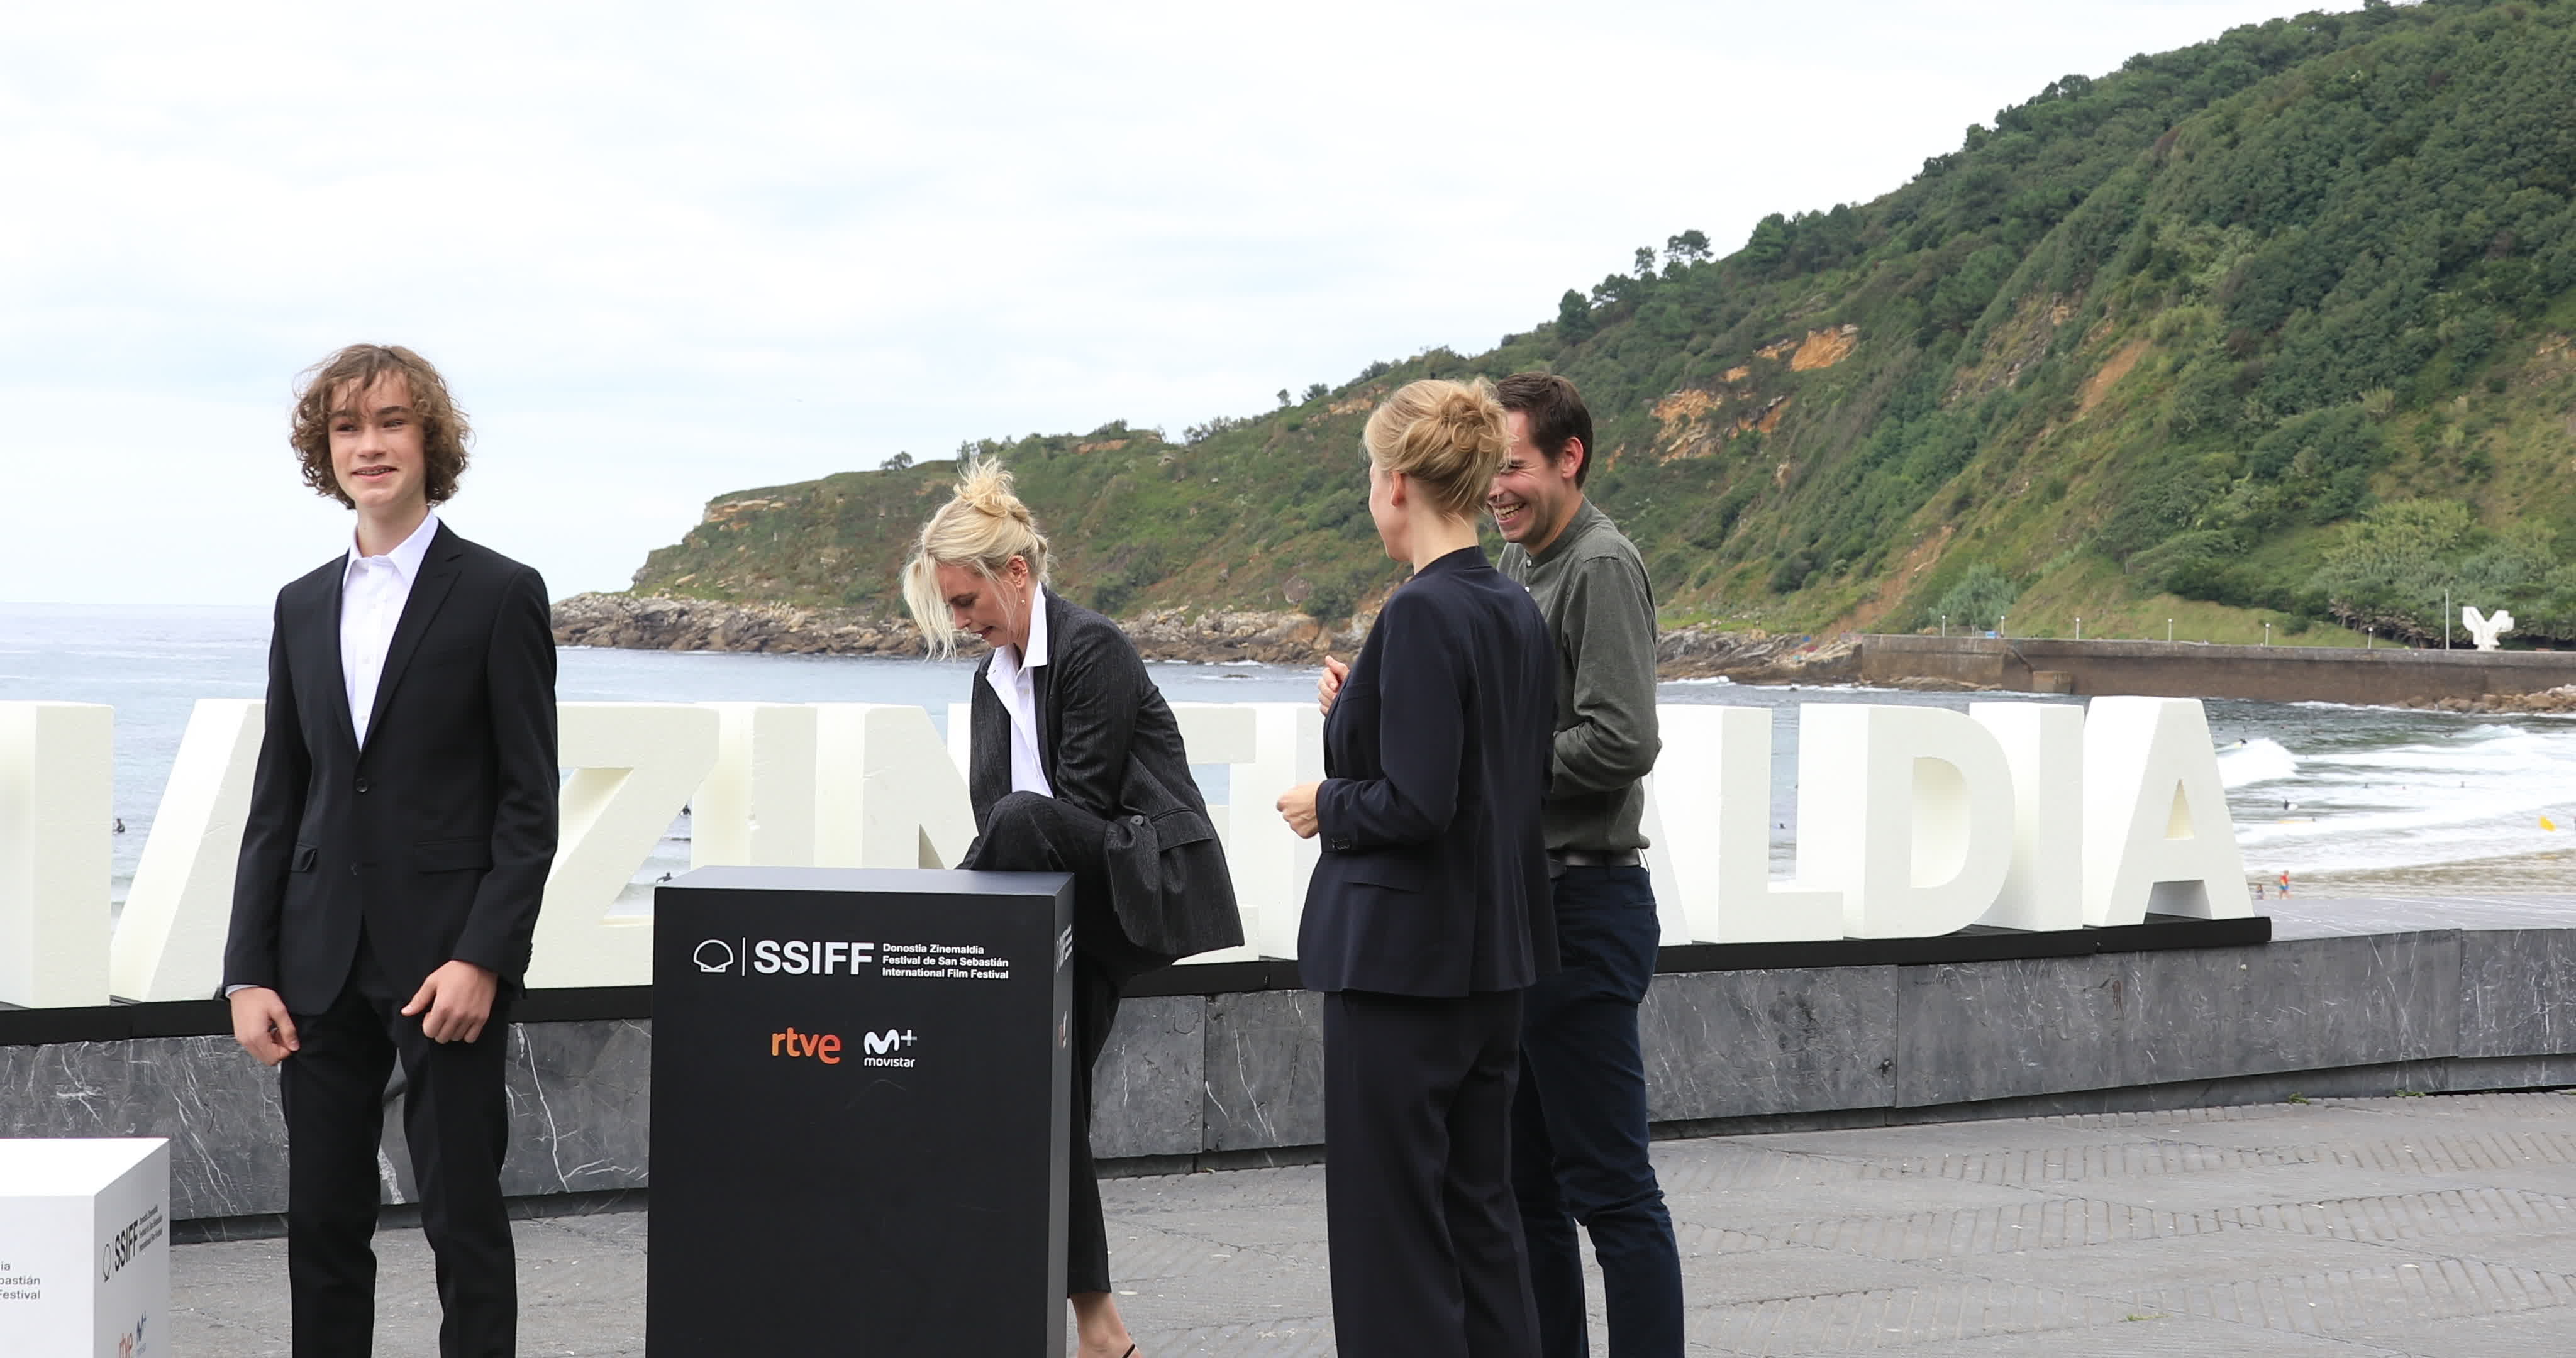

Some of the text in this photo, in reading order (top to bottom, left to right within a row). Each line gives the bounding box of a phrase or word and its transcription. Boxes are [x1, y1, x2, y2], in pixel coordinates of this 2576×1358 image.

[883, 943, 985, 954] Donostia Zinemaldia
[754, 940, 874, 974] SSIFF
[882, 955, 1009, 967] Festival de San Sebastián
[882, 968, 1009, 979] International Film Festival
[772, 1028, 840, 1064] rtve
[864, 1057, 915, 1067] movistar
[115, 1219, 138, 1272] SSIFF
